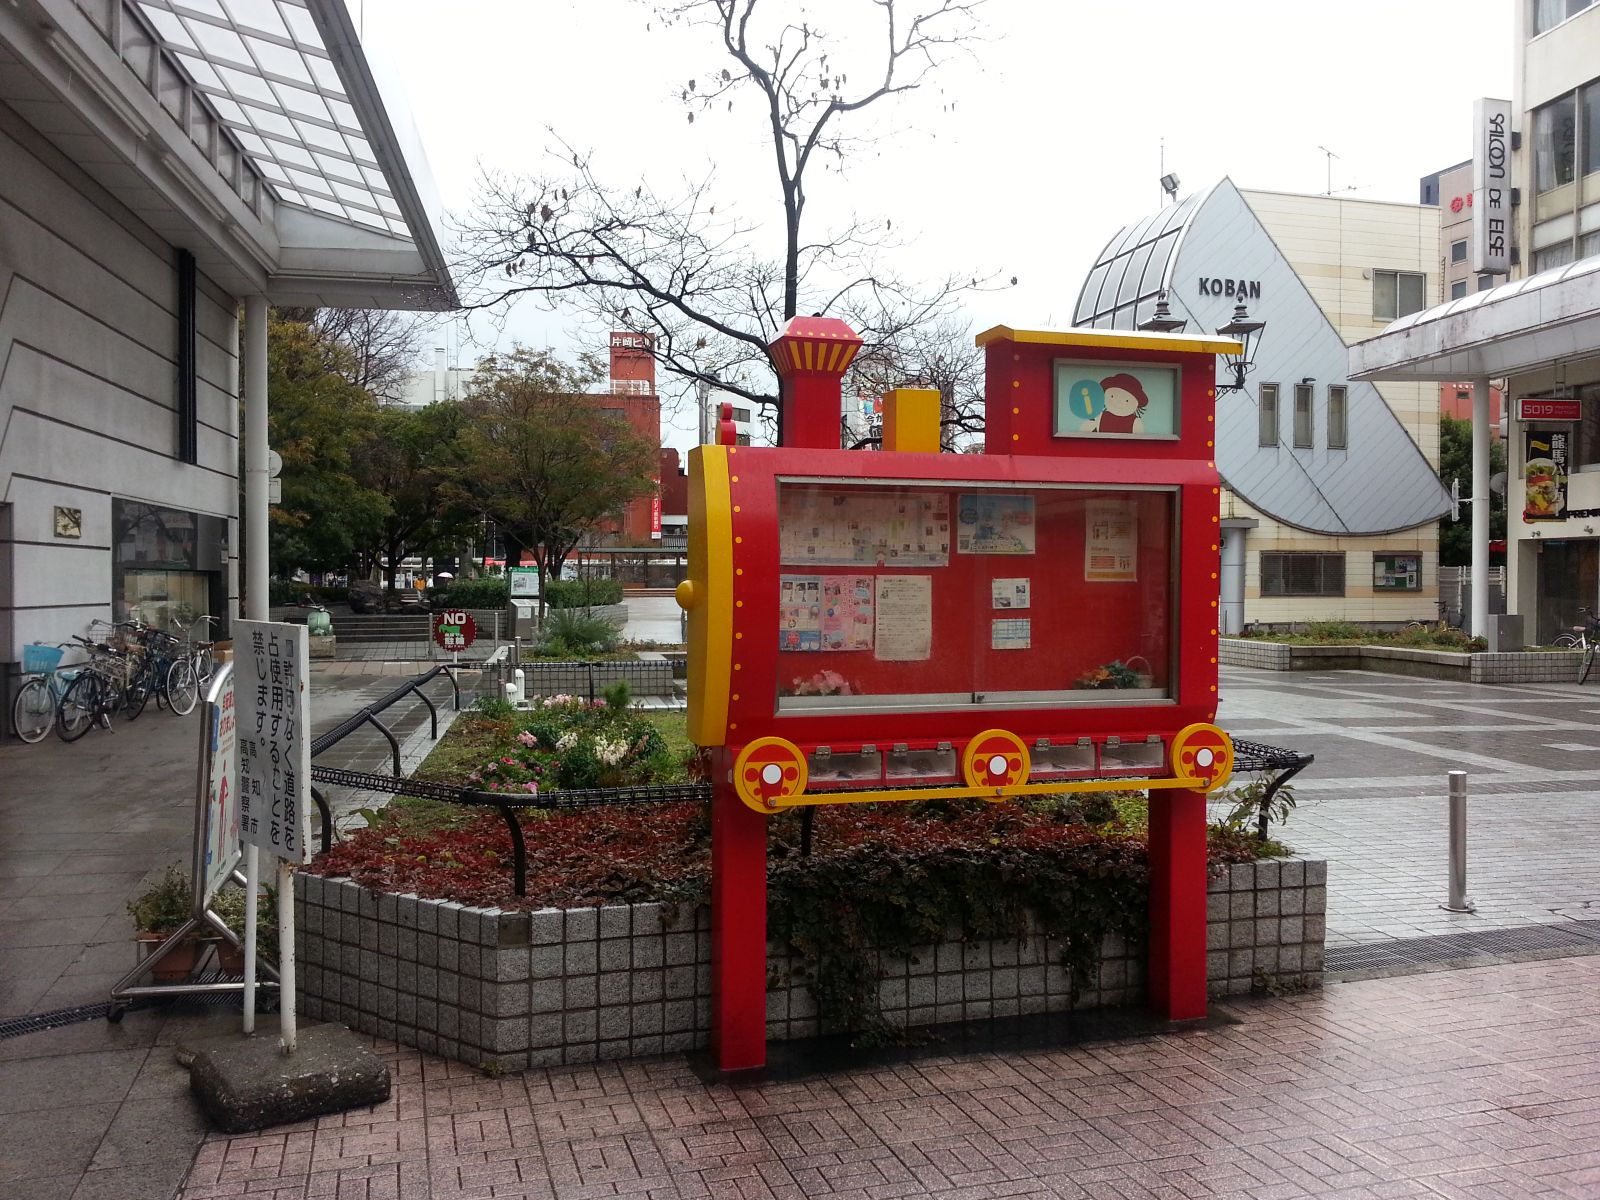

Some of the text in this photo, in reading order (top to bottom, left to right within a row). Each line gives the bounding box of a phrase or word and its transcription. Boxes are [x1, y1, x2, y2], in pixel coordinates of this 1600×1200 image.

[1489, 188, 1501, 208] DE
[1489, 218, 1504, 256] ELSE
[1199, 277, 1260, 299] KOBAN
[1523, 404, 1554, 415] 5019
[443, 613, 467, 625] NO
[252, 629, 268, 747] 禁じます。
[283, 660, 296, 852] 許可なく道路を
[240, 738, 250, 833] 高知警察署
